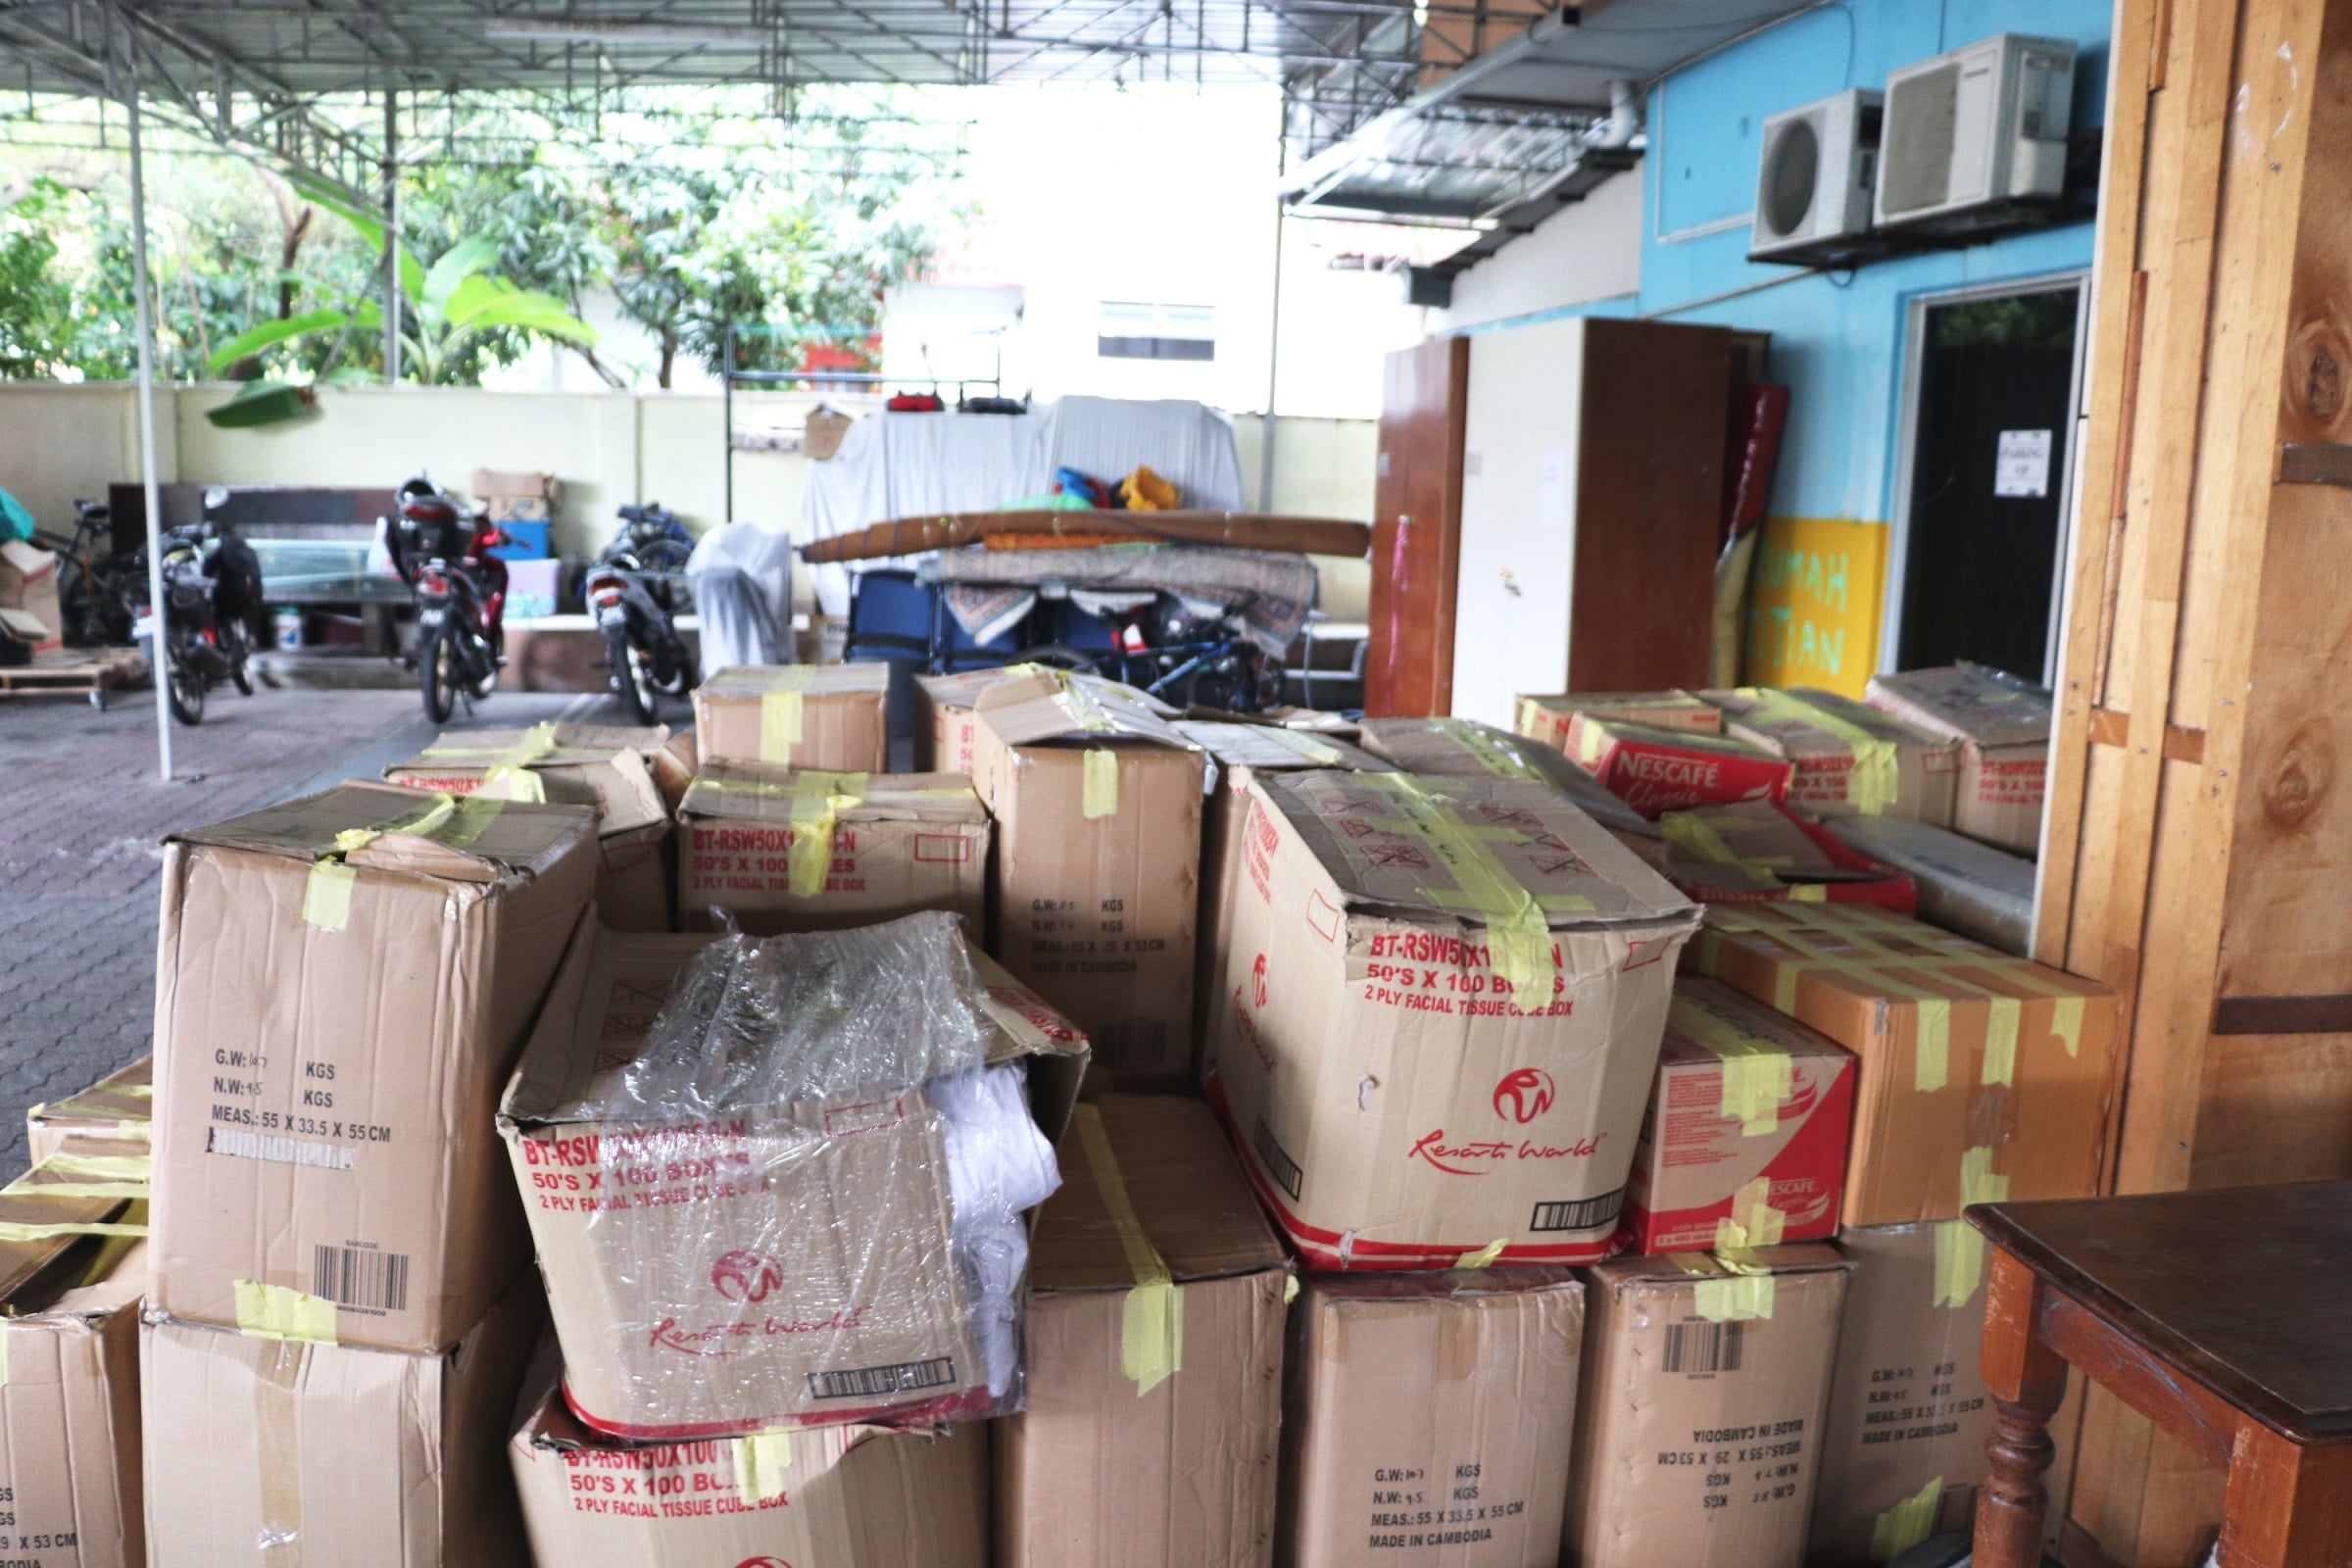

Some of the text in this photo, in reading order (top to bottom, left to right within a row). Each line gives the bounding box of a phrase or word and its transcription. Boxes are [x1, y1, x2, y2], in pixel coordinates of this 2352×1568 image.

[1617, 749, 1721, 788] NESCAFÉ
[737, 857, 750, 871] X
[757, 858, 789, 872] 100
[1102, 900, 1124, 911] KGS
[1101, 920, 1124, 932] KGS
[1367, 962, 1414, 986] 50'S
[1421, 971, 1439, 989] X
[1446, 972, 1485, 994] 100
[1364, 984, 1373, 1001] 2
[1377, 988, 1402, 1006] PLY
[1405, 993, 1453, 1014] FACIAL
[1458, 999, 1504, 1016] TISSUE
[1547, 1001, 1574, 1016] BOX
[215, 1049, 247, 1067] G.W:
[306, 1061, 335, 1080] KGS
[214, 1077, 245, 1096] N.W:
[304, 1090, 333, 1108] KGS
[212, 1104, 391, 1143] MEAS.: 55 X 33.5 X 55 CM
[1518, 1135, 1600, 1159] World
[532, 1172, 580, 1192] 50'S
[588, 1173, 605, 1190] X
[540, 1195, 551, 1208] 2
[552, 1198, 575, 1211] PLY
[1971, 1396, 1984, 1410] CM
[1692, 1426, 1755, 1443] CAMBODIA
[1759, 1424, 1771, 1437] IN
[1907, 1422, 1958, 1439] CAMBODIA
[1657, 1452, 1677, 1464] CM
[1680, 1452, 1693, 1464] 53
[1698, 1452, 1708, 1464] X
[1715, 1450, 1730, 1463] 29
[1738, 1450, 1746, 1461] X
[1750, 1446, 1763, 1459] 55
[1375, 1468, 1404, 1482] G.W:
[1455, 1463, 1481, 1479] KGS
[1706, 1473, 1731, 1487] KGS
[570, 1474, 615, 1493] 50'S
[621, 1477, 637, 1495] X
[644, 1475, 685, 1495] 100
[1373, 1491, 1402, 1504] N.W:
[1453, 1487, 1479, 1500] KGS
[1703, 1494, 1728, 1508] KGS
[574, 1497, 583, 1511] 2
[587, 1499, 609, 1513] PLY
[612, 1501, 658, 1517] FACIAL
[661, 1498, 712, 1517] TISSUE
[1371, 1500, 1524, 1527] MEAS.: 55 X 33.5 X 55 CM
[19, 1536, 29, 1549] X
[33, 1535, 51, 1548] 53
[55, 1532, 77, 1547] CM
[1369, 1528, 1493, 1547] MADE IN CAMBODIA
